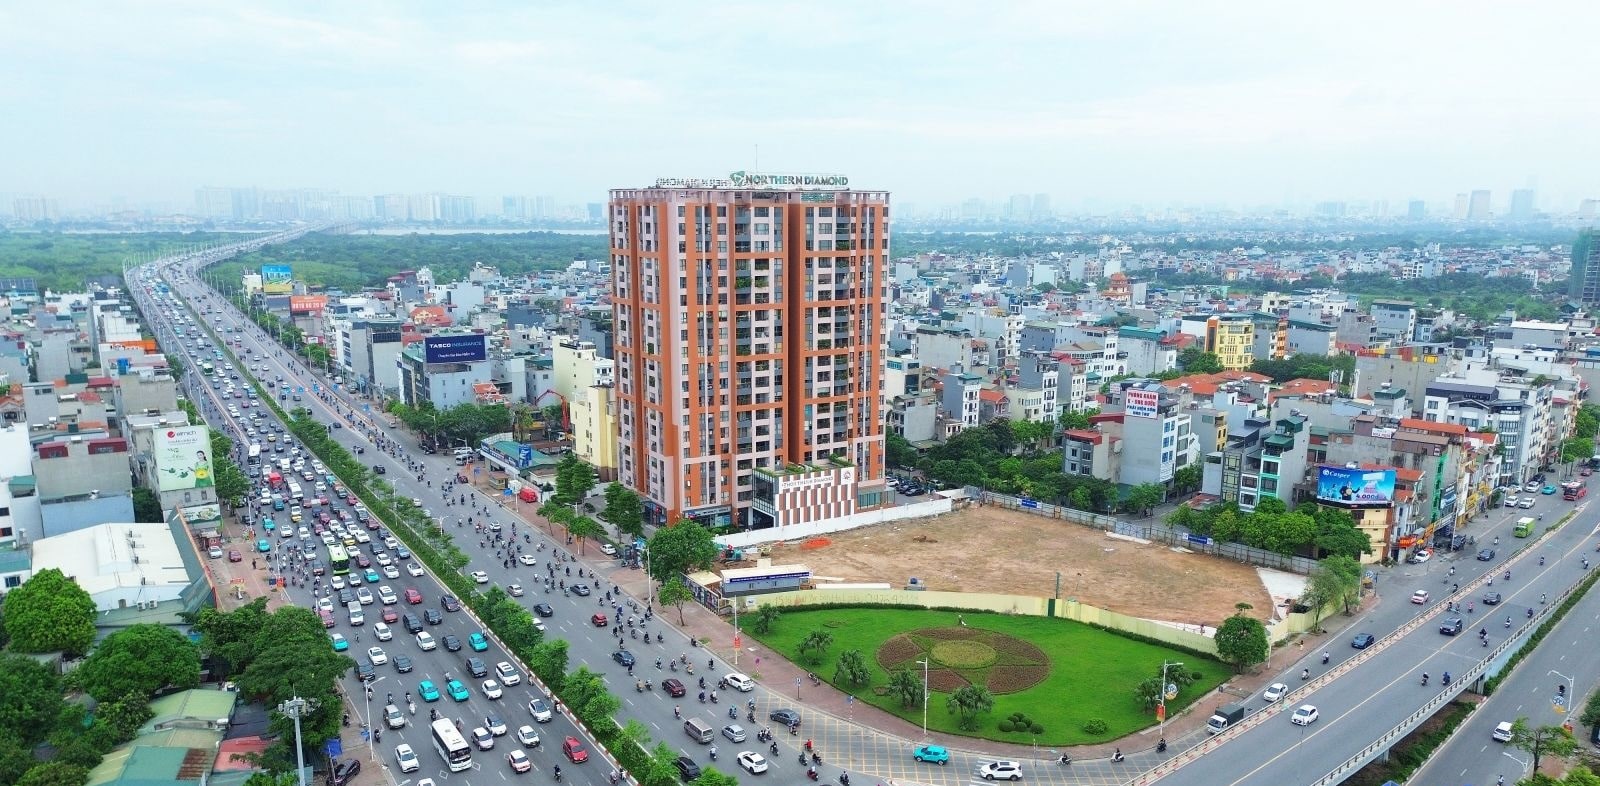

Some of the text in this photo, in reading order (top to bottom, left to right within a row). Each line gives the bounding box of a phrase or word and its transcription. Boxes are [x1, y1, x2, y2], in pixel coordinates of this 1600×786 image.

[745, 174, 849, 186] NORTHERN DIAMOND
[452, 340, 482, 348] INSURANCE
[1329, 471, 1351, 479] Casper
